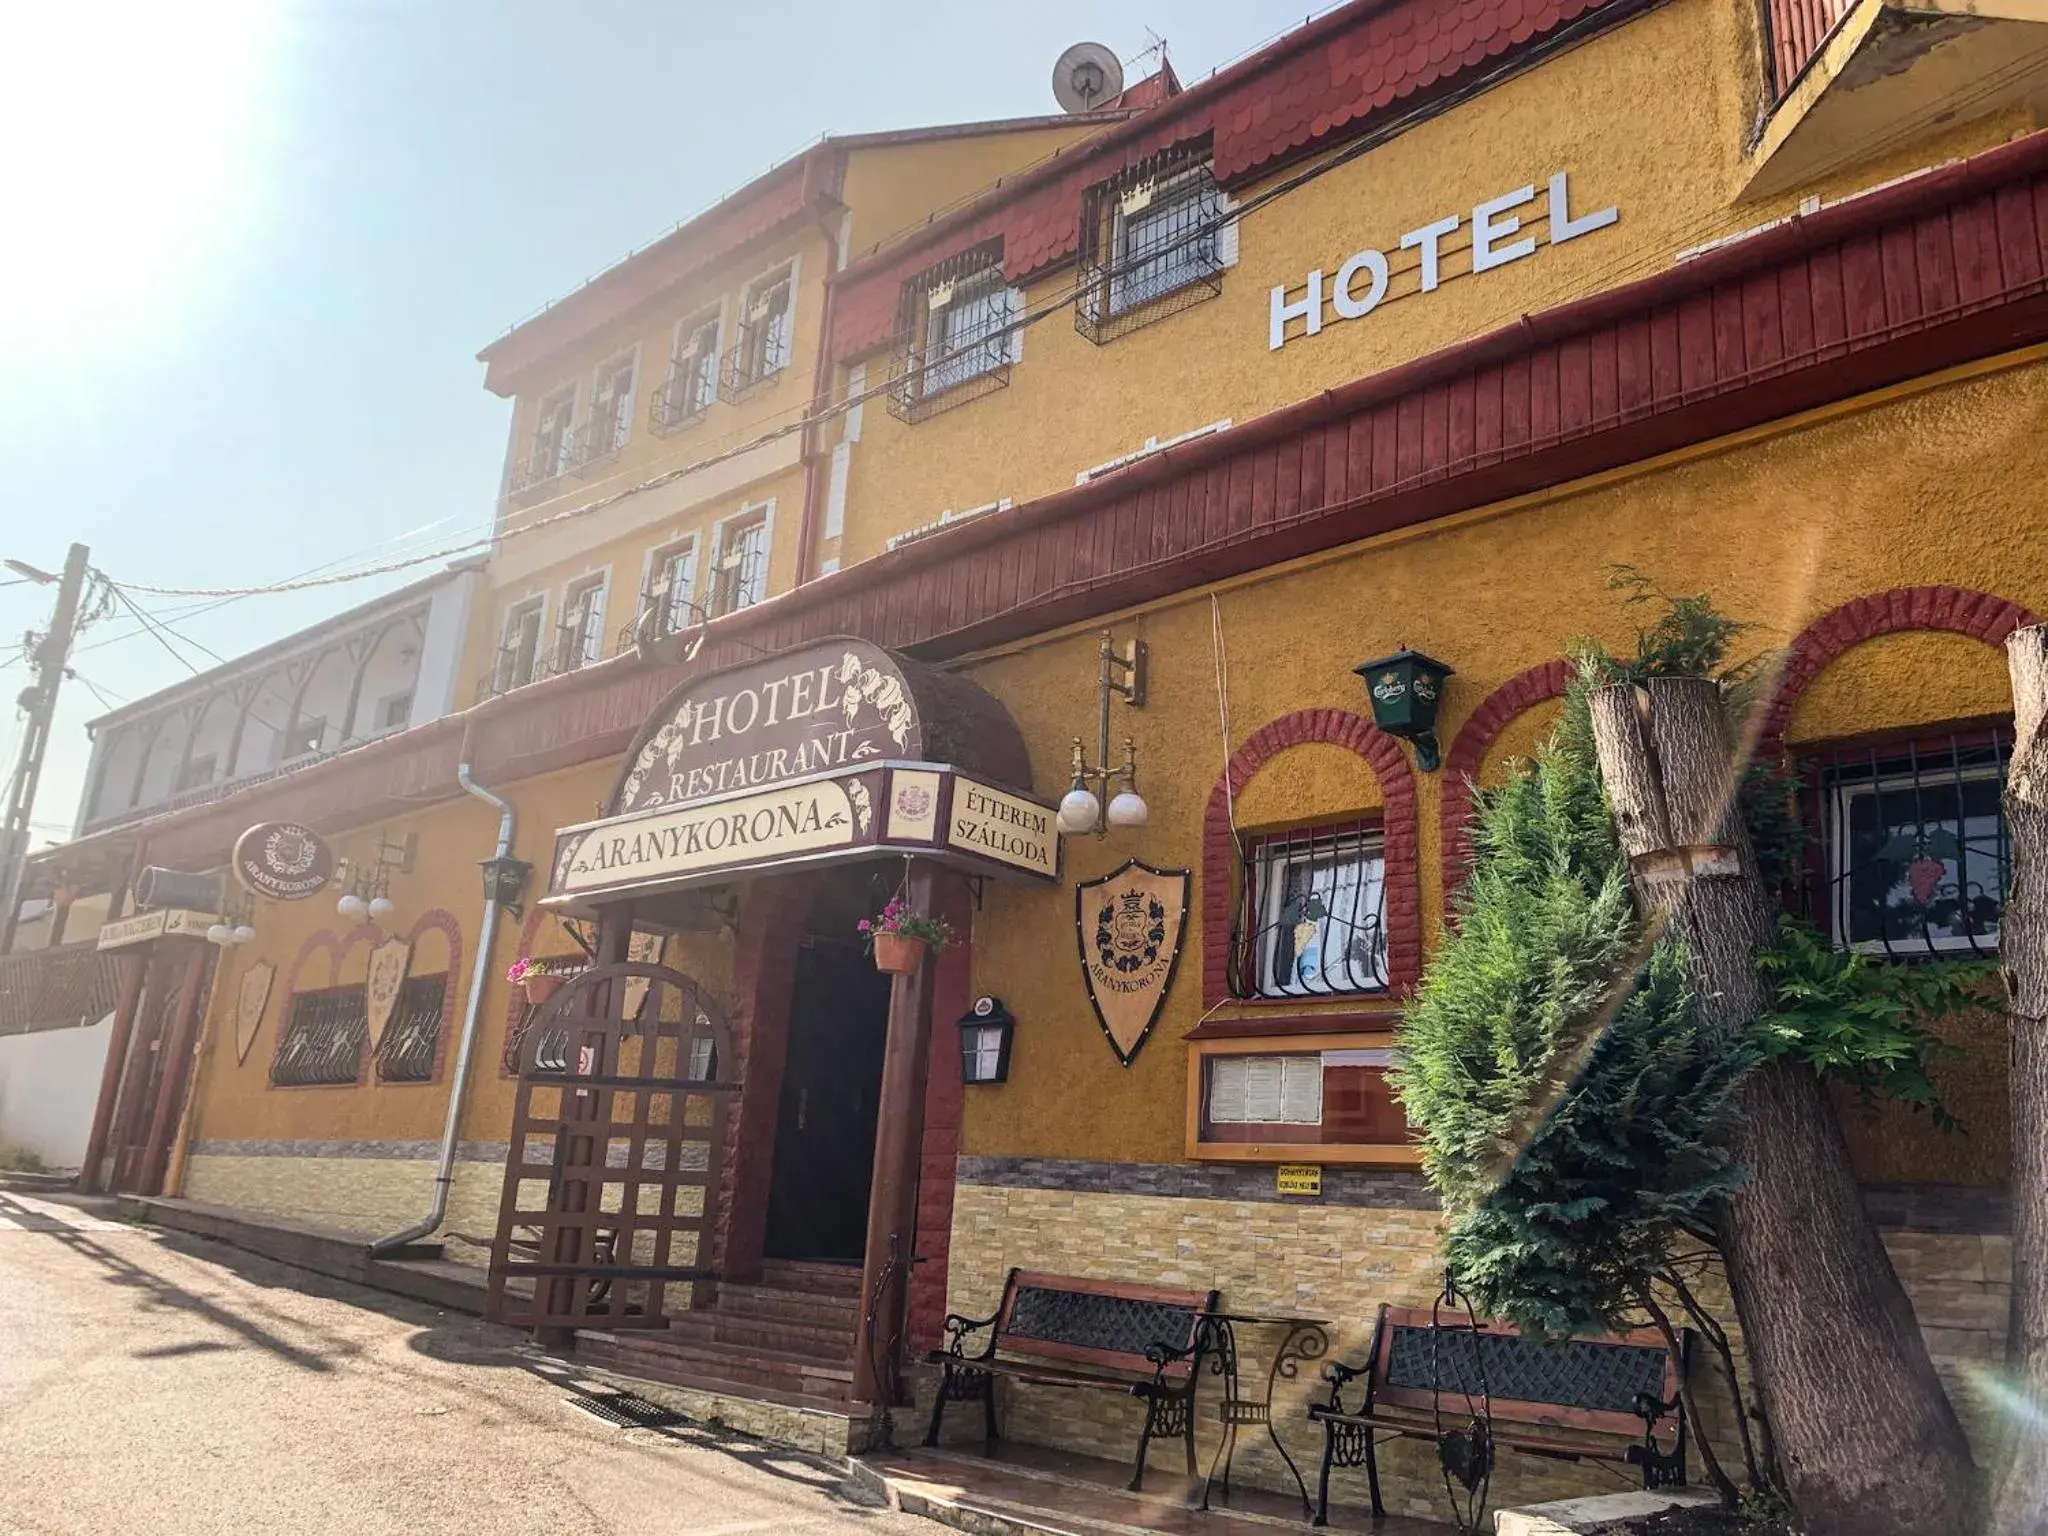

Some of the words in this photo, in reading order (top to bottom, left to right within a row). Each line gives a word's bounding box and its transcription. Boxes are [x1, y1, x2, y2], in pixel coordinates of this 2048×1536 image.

[1269, 171, 1619, 351] HOTEL
[688, 664, 843, 746] HOTEL
[667, 728, 855, 804] RESTAURANT
[590, 797, 823, 872] ARANYKORONA
[955, 818, 1049, 866] SZÁLLODA
[966, 787, 1047, 835] ÉTTEREM
[1089, 958, 1170, 993] ARANYKORONA
